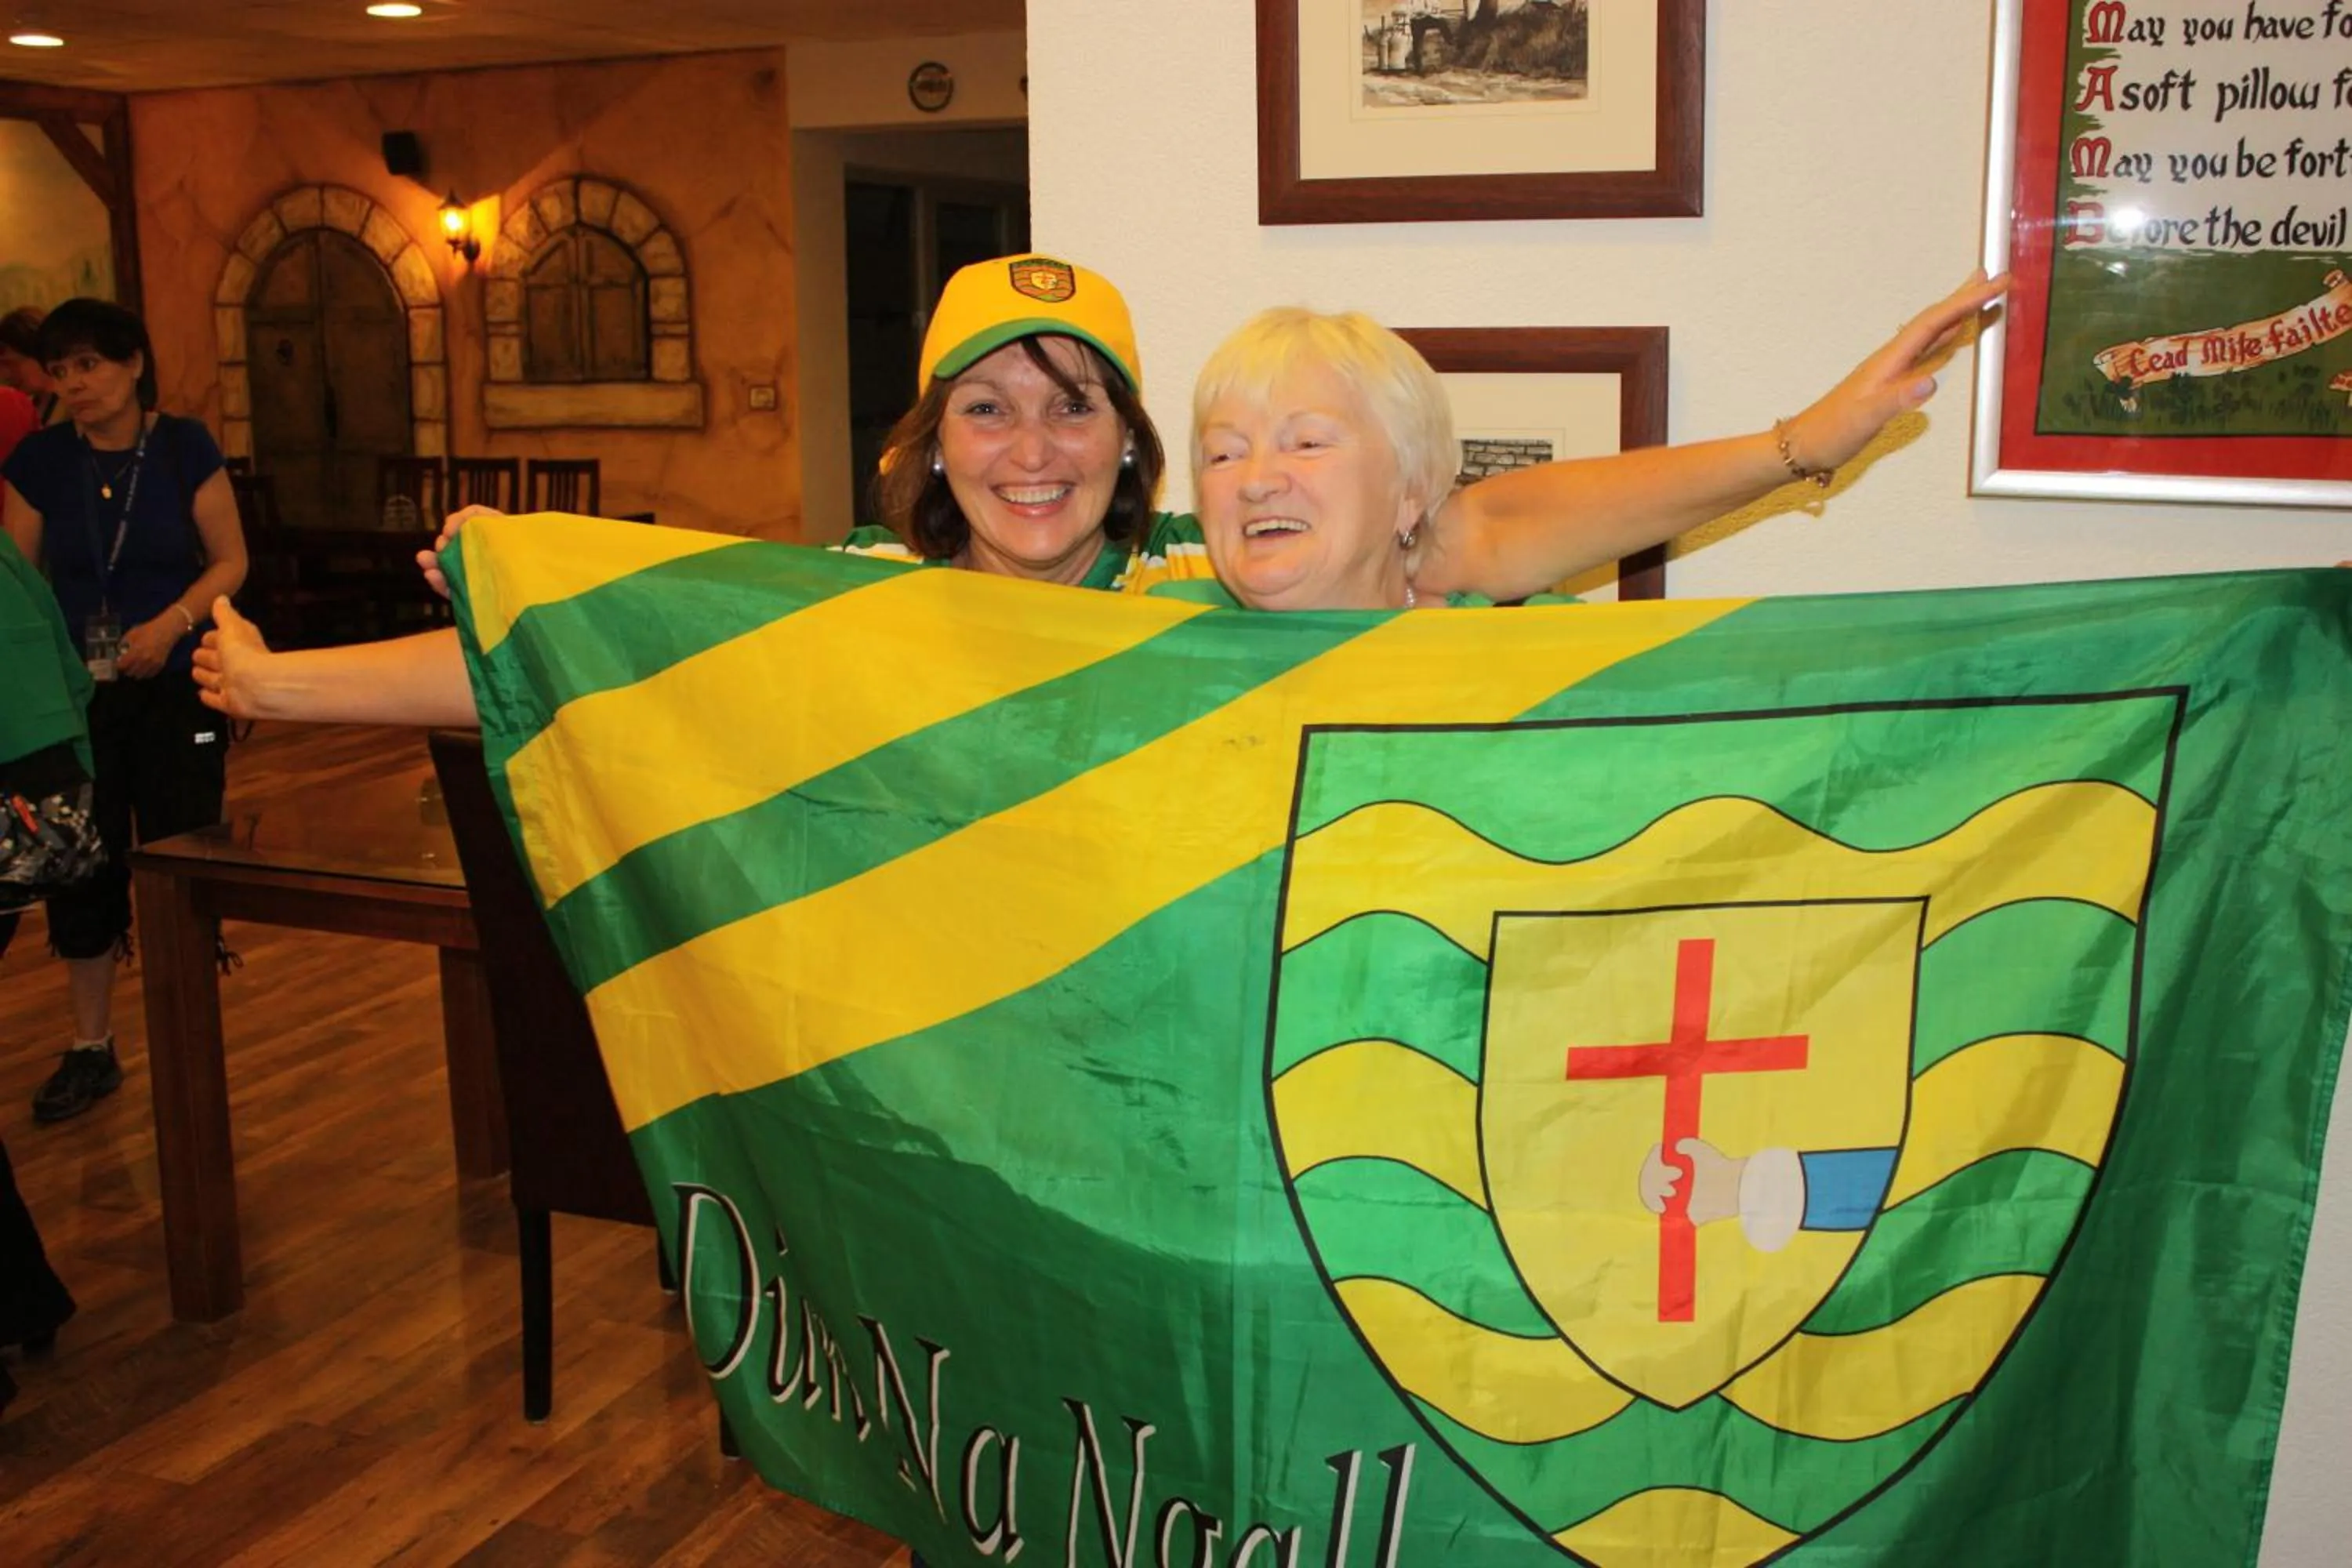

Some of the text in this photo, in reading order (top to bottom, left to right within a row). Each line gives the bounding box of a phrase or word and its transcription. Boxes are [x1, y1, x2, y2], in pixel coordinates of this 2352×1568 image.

[2085, 1, 2165, 46] May
[2183, 17, 2234, 46] you
[2244, 0, 2314, 43] have
[2074, 65, 2118, 111] A
[2119, 69, 2197, 112] soft
[2216, 66, 2321, 122] pillow
[2071, 135, 2352, 183] May you be fort
[2063, 201, 2347, 248] Beore the devil
[858, 1312, 1023, 1563] Na
